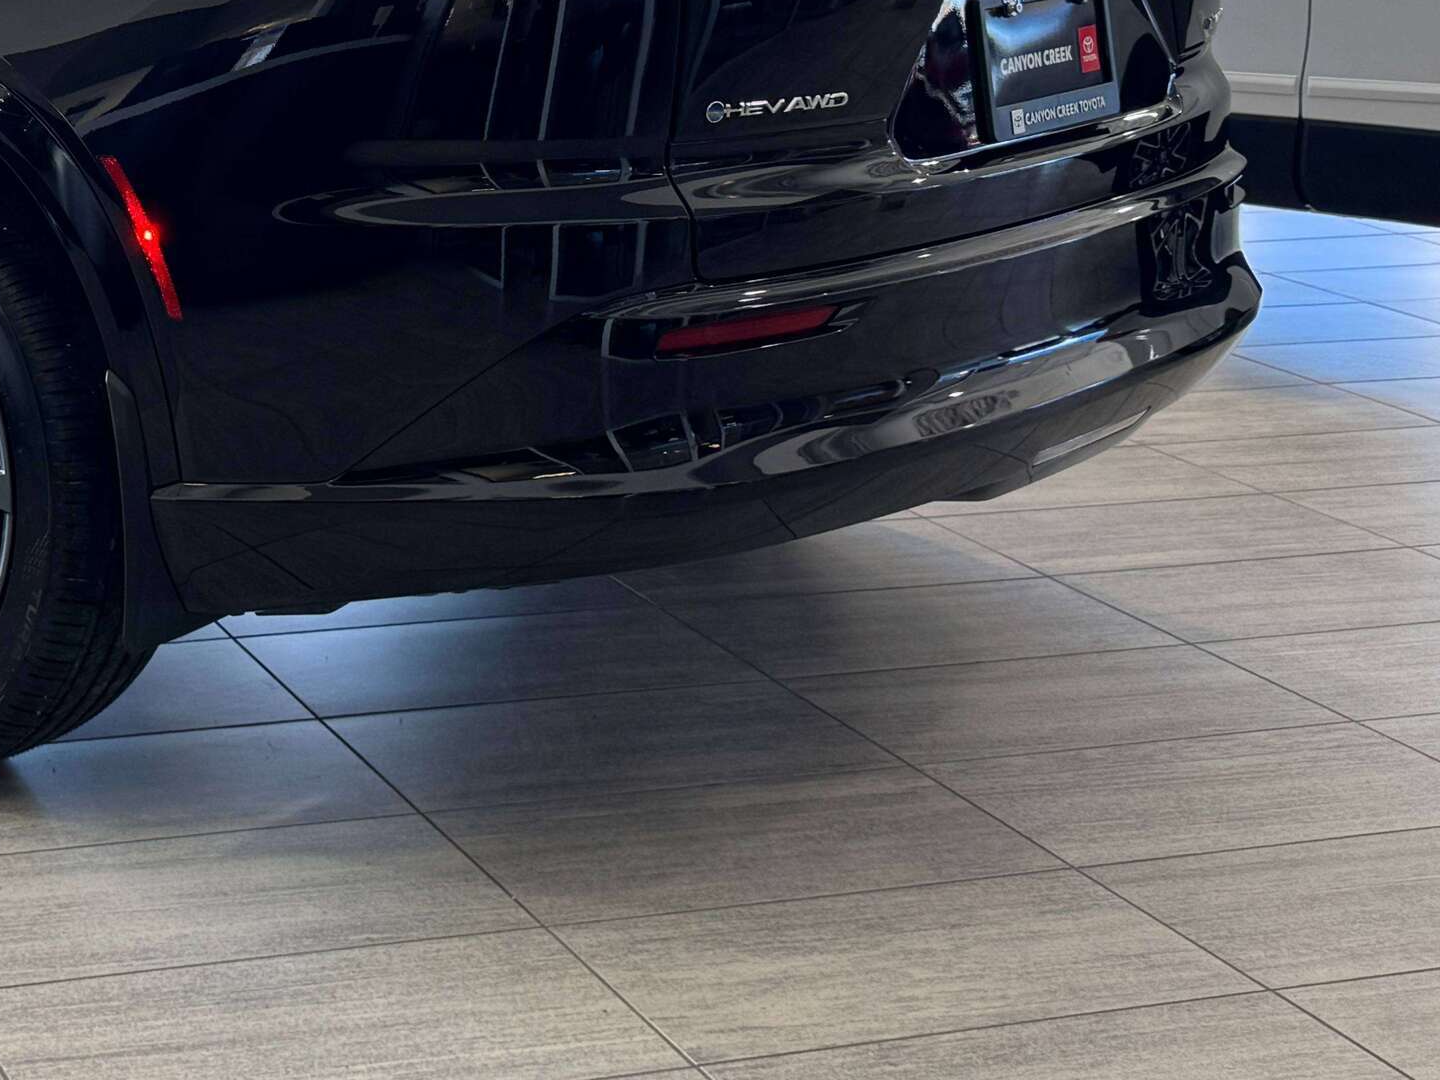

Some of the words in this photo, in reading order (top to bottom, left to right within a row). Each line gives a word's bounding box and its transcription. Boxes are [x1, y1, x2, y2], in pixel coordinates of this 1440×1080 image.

[1000, 51, 1043, 76] CANYON
[1043, 44, 1073, 67] CREEK
[1025, 108, 1057, 126] CANYON
[1056, 101, 1080, 119] CREEK
[1078, 95, 1106, 113] TOYOTA
